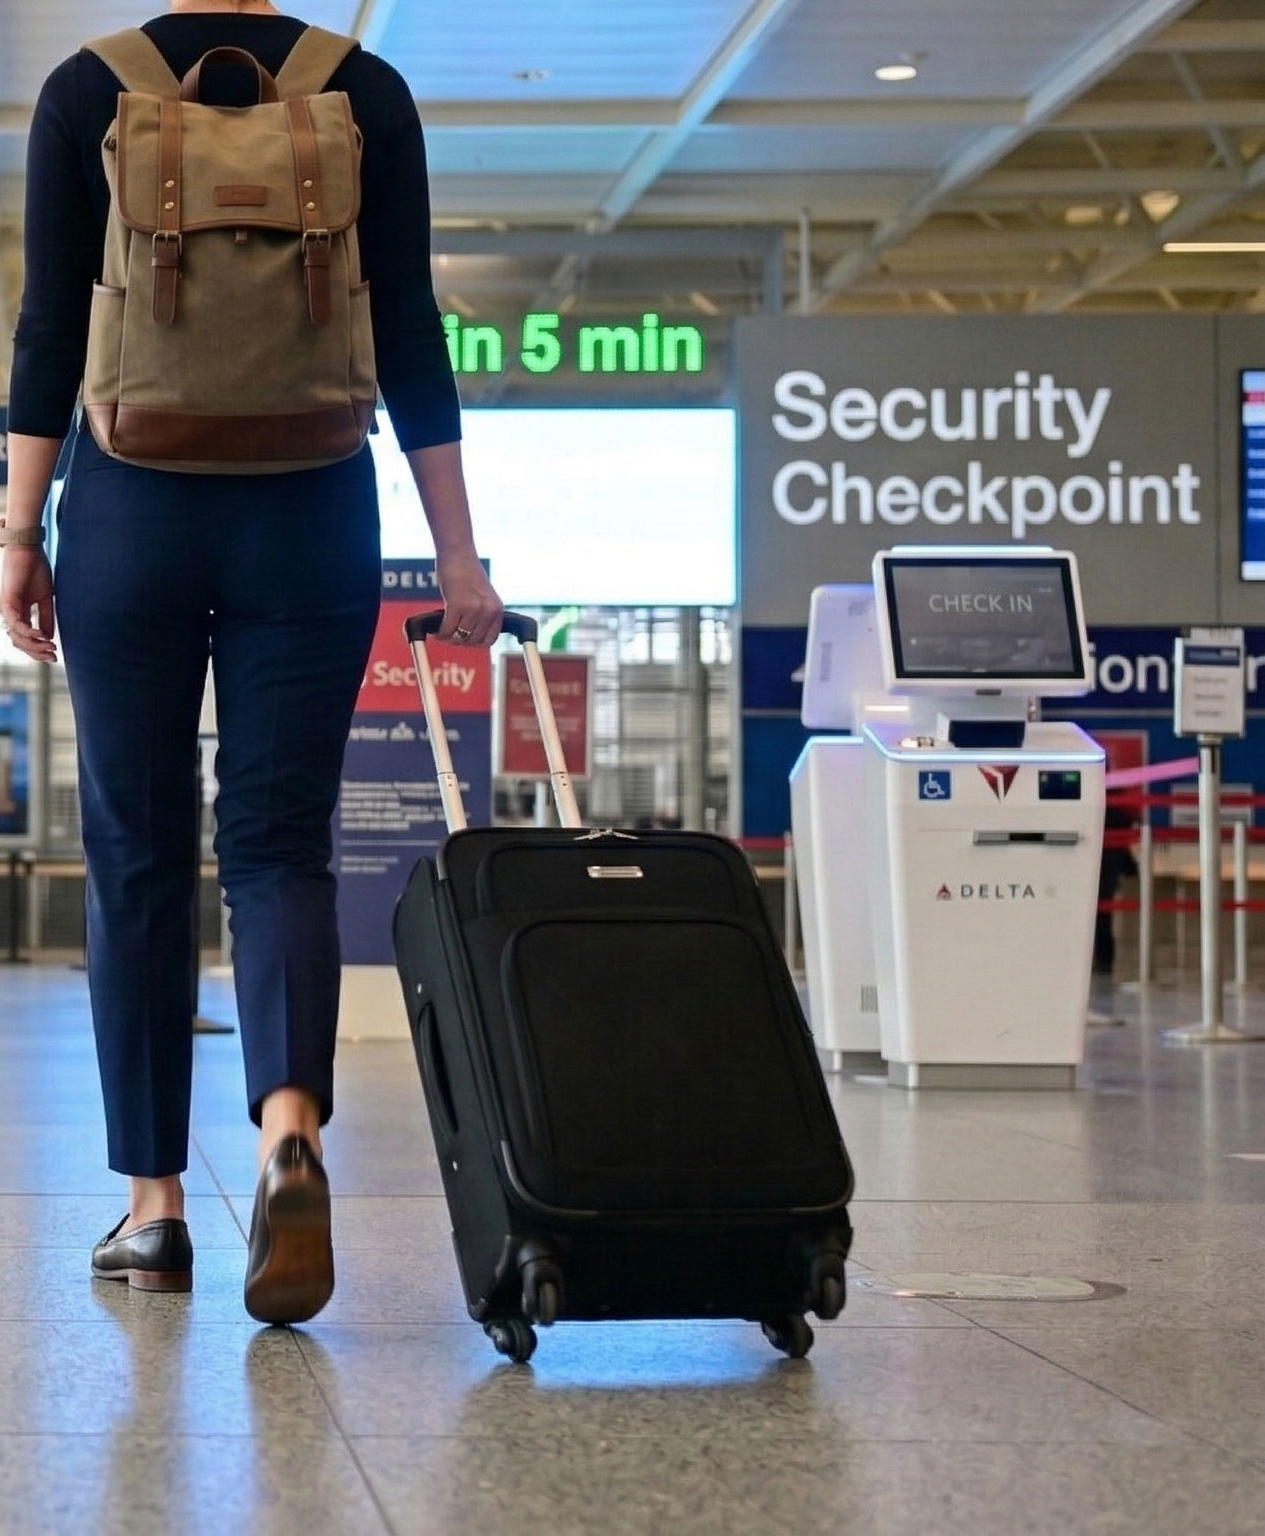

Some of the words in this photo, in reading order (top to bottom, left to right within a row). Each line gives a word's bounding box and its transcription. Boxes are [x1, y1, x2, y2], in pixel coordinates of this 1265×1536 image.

[444, 314, 502, 372] in
[520, 314, 561, 372] 5
[579, 313, 702, 372] min
[772, 370, 1111, 458] Security
[772, 460, 1200, 539] Checkpoint
[928, 594, 1003, 613] CHECK
[1010, 594, 1033, 613] IN
[373, 661, 475, 692] Secrity
[961, 884, 1036, 899] DELTA
